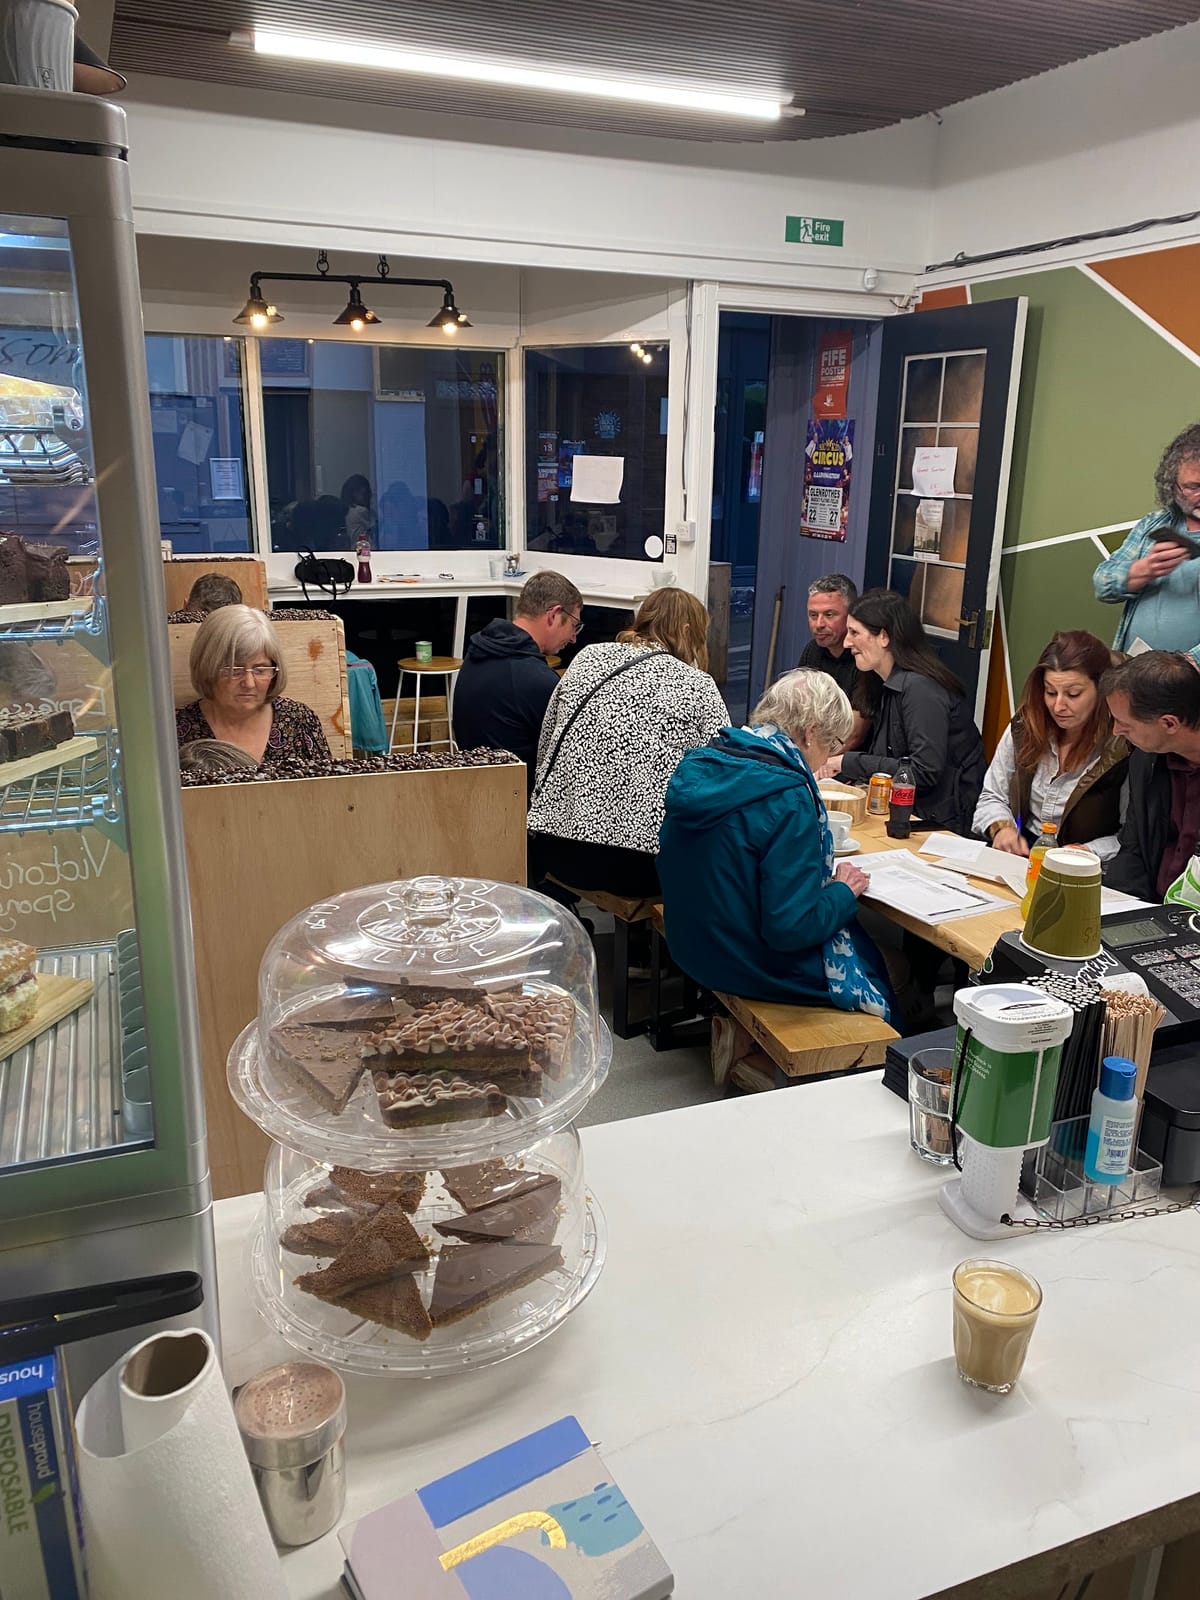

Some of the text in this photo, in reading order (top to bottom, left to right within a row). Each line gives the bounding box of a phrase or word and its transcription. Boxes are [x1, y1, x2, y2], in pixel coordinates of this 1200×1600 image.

[815, 221, 831, 232] Fire
[814, 233, 830, 242] exit
[821, 348, 847, 367] FIFE
[820, 366, 846, 376] POSTER
[812, 451, 844, 466] CIRCUS
[27, 1400, 56, 1480] houseproud
